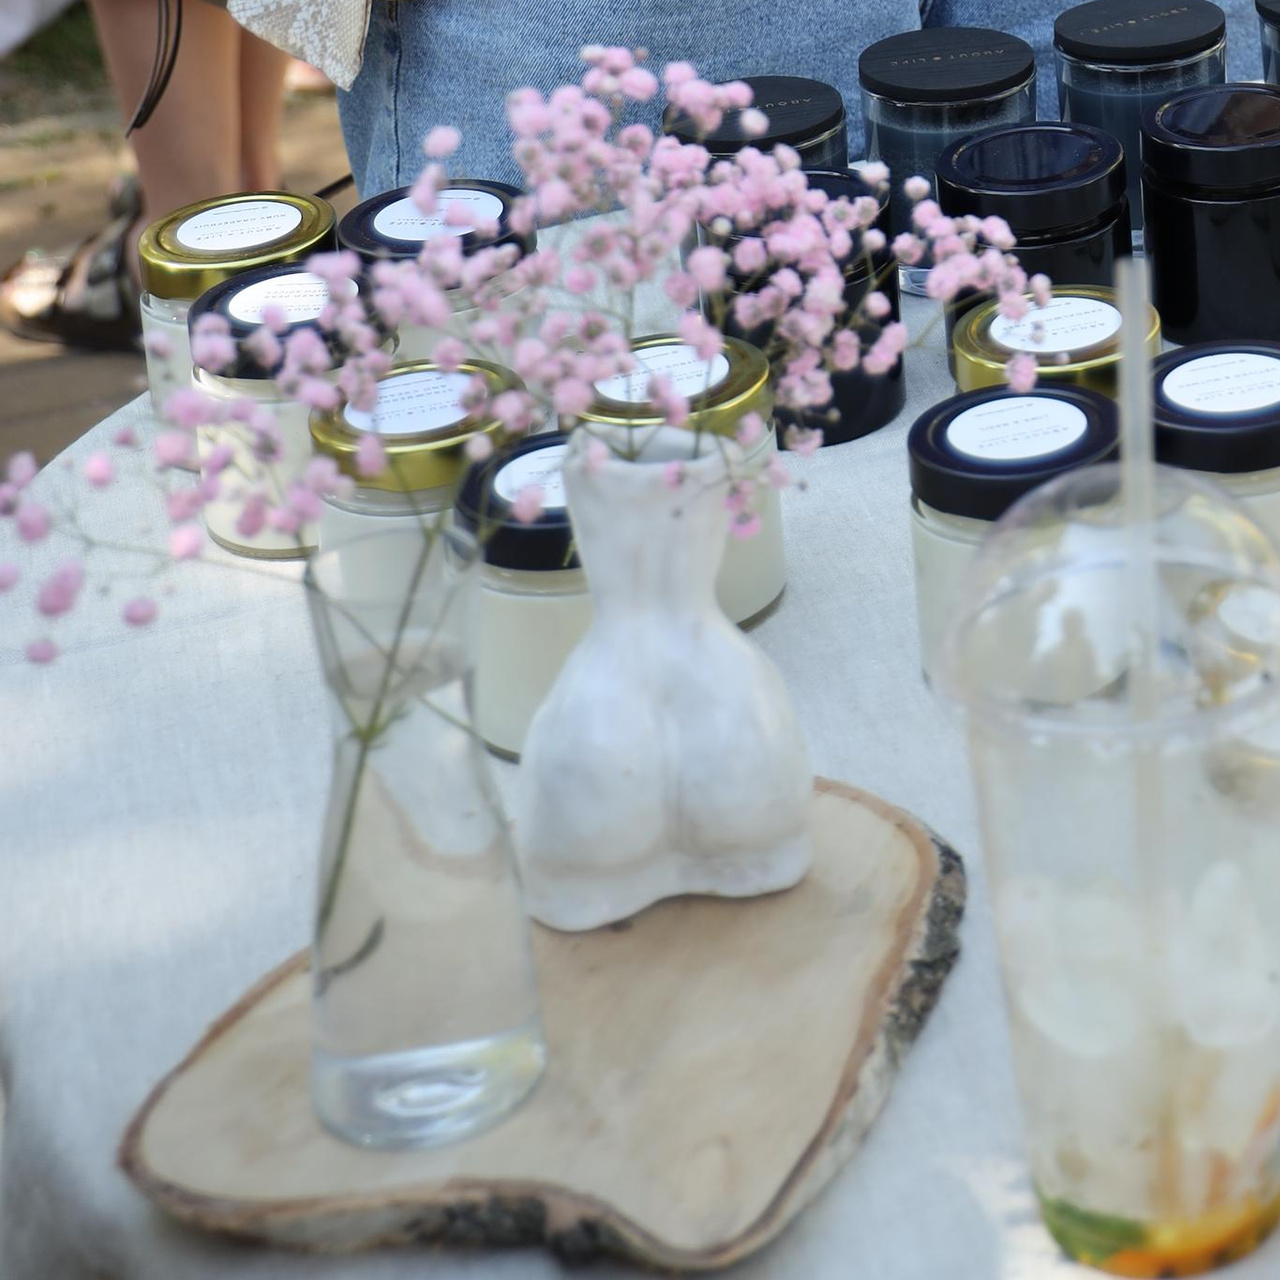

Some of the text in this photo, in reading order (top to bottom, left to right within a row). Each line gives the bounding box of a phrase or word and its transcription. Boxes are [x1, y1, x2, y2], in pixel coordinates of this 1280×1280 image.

[1091, 7, 1187, 33] ABOUT LIFE
[949, 49, 1004, 59] ABOUT
[193, 217, 256, 229] GRAPEFRUIT
[196, 225, 281, 241] ABOUT LIFE
[1030, 308, 1102, 326] SANDALWOD
[1064, 322, 1105, 334] ABOUT
[423, 383, 446, 391] AND
[376, 387, 453, 405] STRAWBERRY
[378, 388, 419, 400] CREAM
[1025, 427, 1069, 439] ABOUT
